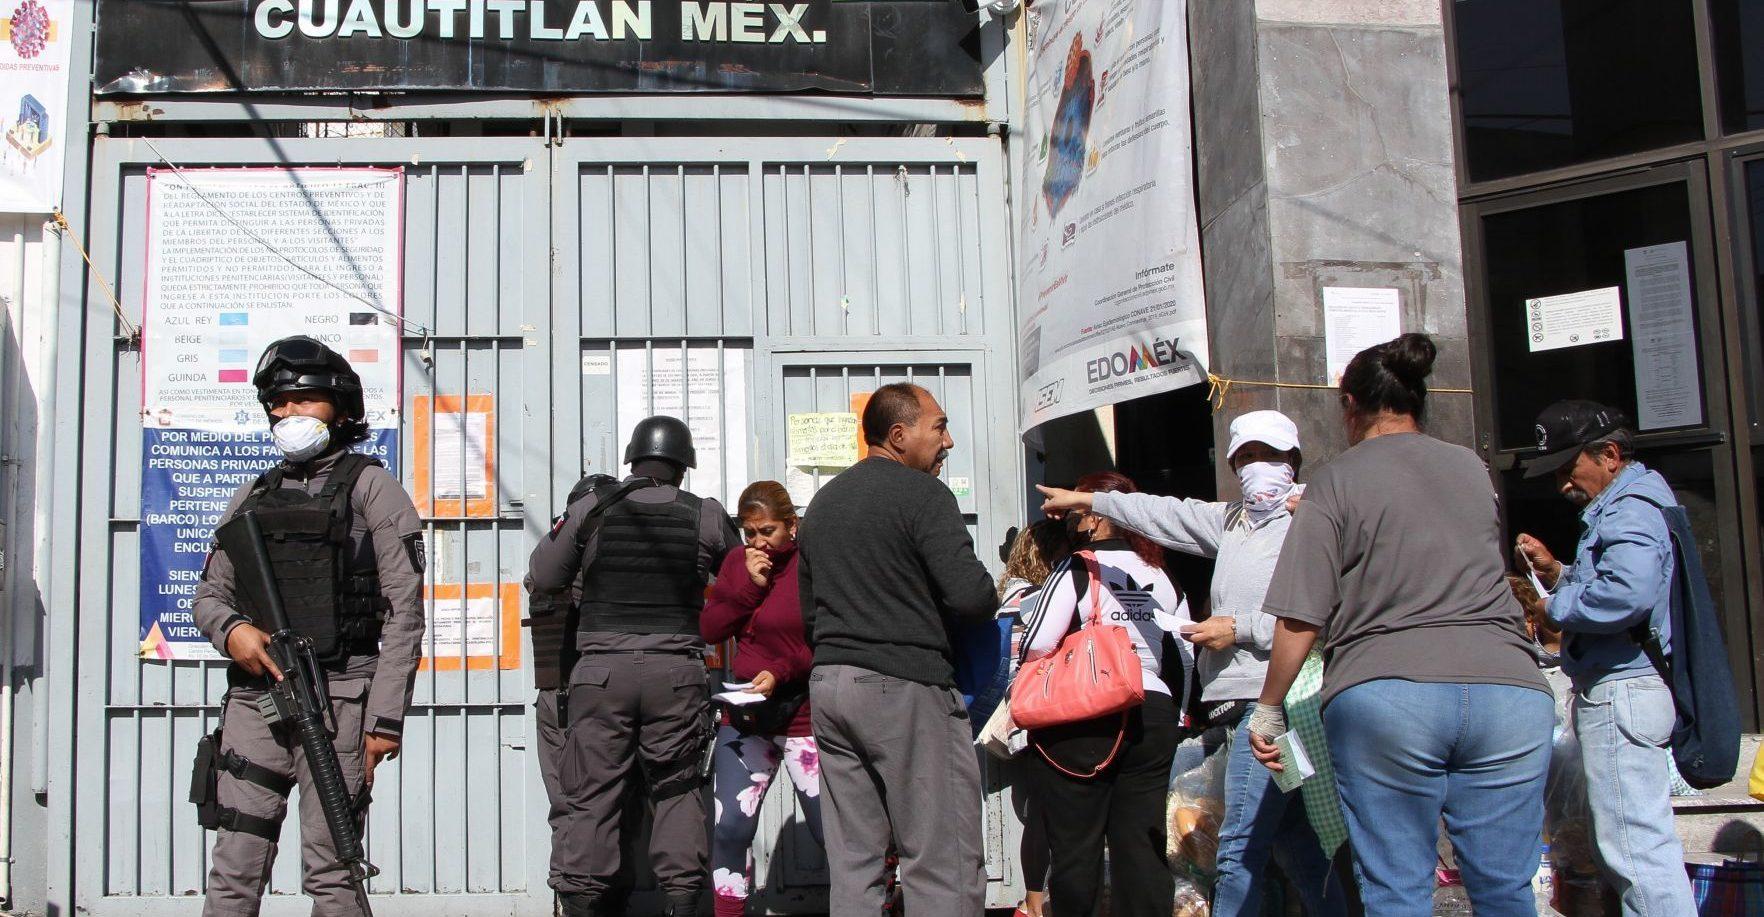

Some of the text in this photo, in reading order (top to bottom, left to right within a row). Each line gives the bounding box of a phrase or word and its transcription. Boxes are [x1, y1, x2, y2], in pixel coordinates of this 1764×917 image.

[254, 0, 651, 40] CUAUTITLAN
[0, 64, 60, 73] DIDAS PREVENTIVAS
[1135, 262, 1175, 281] Infórmate
[164, 316, 213, 325] AZUL REY
[304, 315, 339, 324] NEGRO
[174, 335, 202, 344] BEIGE
[177, 353, 199, 363] GRIS
[1086, 337, 1187, 384] EDOMÉX
[168, 373, 207, 382] GUINDA
[161, 432, 188, 443] POR
[189, 432, 233, 443] MEDIO
[234, 432, 260, 443] DEL
[151, 445, 259, 457] COMUNICA A LOS
[363, 445, 388, 457] LAS
[149, 459, 219, 471] PERSONAS
[172, 473, 201, 485] QUE
[204, 473, 213, 484] A
[146, 514, 220, 527] (BARCO) LO
